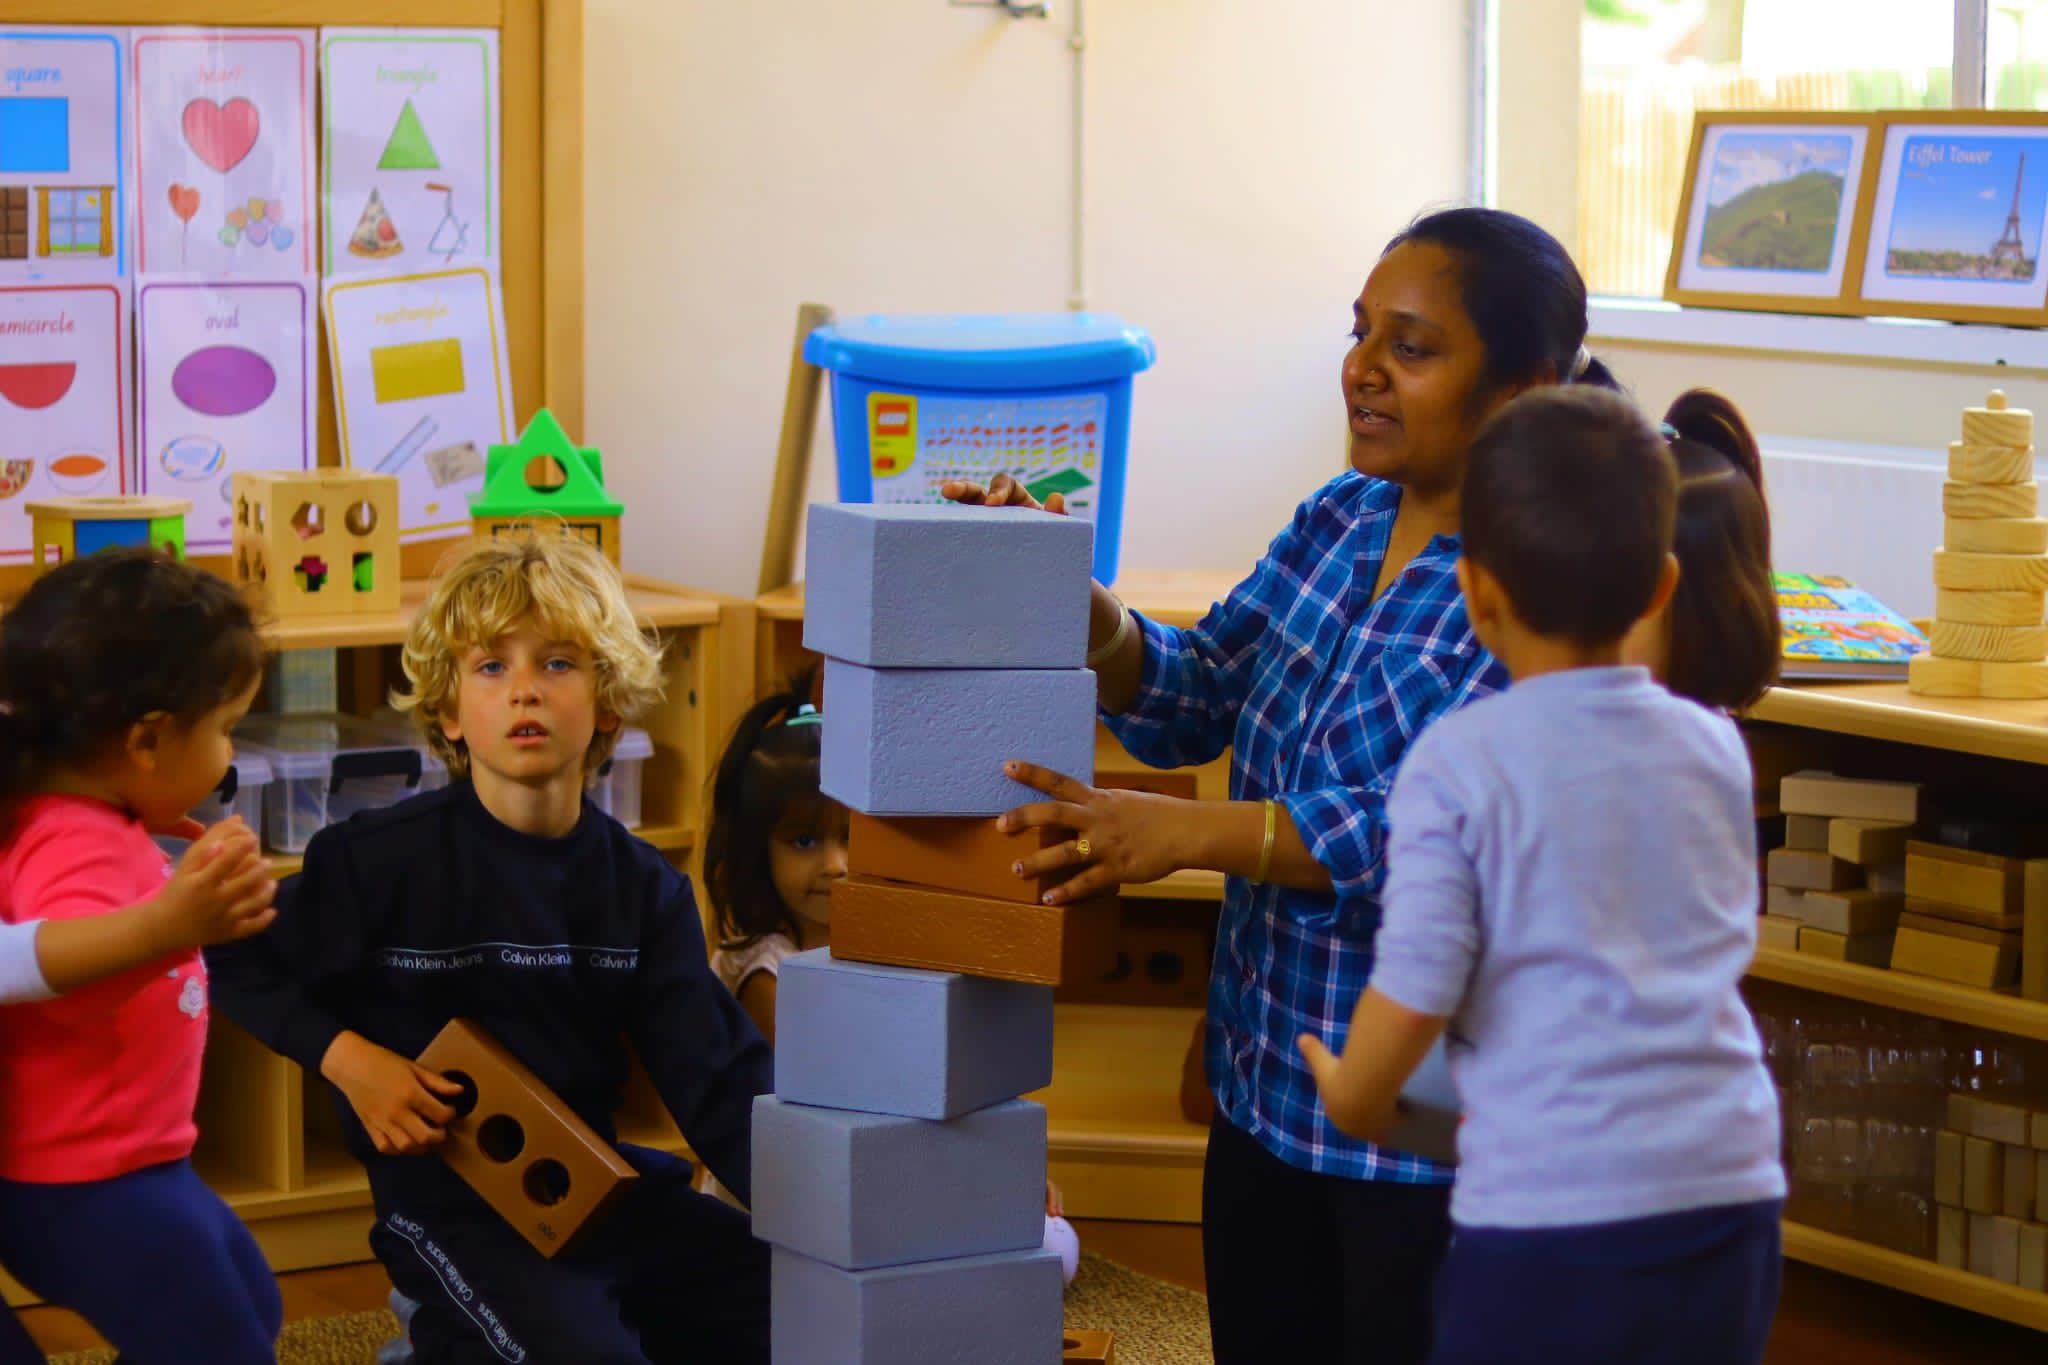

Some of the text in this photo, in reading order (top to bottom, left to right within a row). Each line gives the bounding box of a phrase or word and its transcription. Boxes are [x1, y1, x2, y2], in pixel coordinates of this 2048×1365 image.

[5, 66, 62, 92] square
[377, 64, 438, 92] triangle
[1908, 143, 1992, 168] Eiffel Tower
[0, 310, 75, 335] emicircle
[205, 305, 240, 330] oval
[415, 955, 448, 970] Klein
[448, 951, 484, 970] Jeans
[500, 949, 537, 967] Calvin
[538, 952, 567, 968] Klein
[590, 953, 630, 969] Calvin
